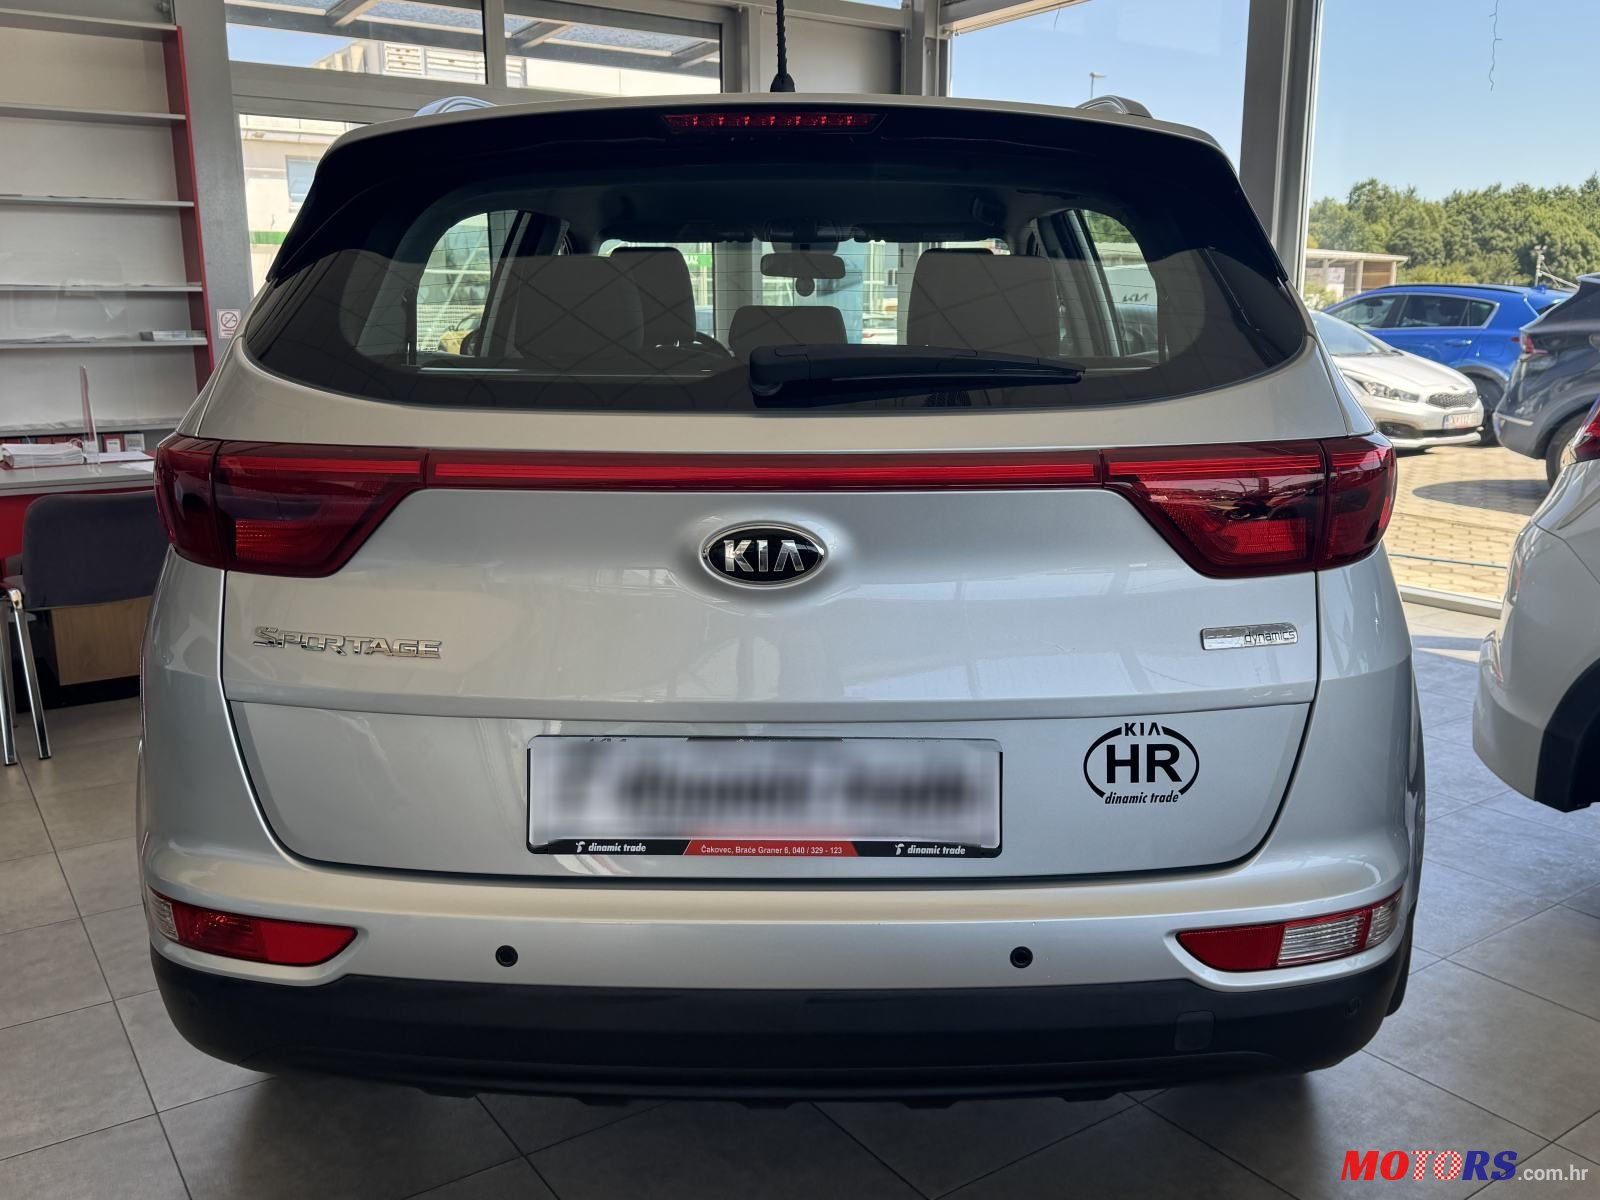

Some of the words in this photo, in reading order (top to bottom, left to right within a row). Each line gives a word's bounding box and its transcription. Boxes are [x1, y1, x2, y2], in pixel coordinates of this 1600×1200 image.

[723, 539, 805, 572] KIA
[253, 626, 442, 659] SPORTAGE
[1244, 630, 1296, 645] dynamics
[1124, 722, 1162, 736] KIA
[1106, 743, 1183, 784] HR
[1104, 791, 1148, 804] dinamic
[1150, 789, 1179, 803] trade
[588, 842, 621, 852] dinamic
[623, 842, 647, 852] trade
[701, 844, 734, 854] Čakovec,
[758, 846, 782, 854] Graner
[784, 846, 791, 855] 6,
[792, 846, 805, 854] 040
[811, 846, 824, 855] 329
[830, 846, 843, 855] 123
[907, 844, 940, 855] dinamic
[942, 844, 966, 855] trade
